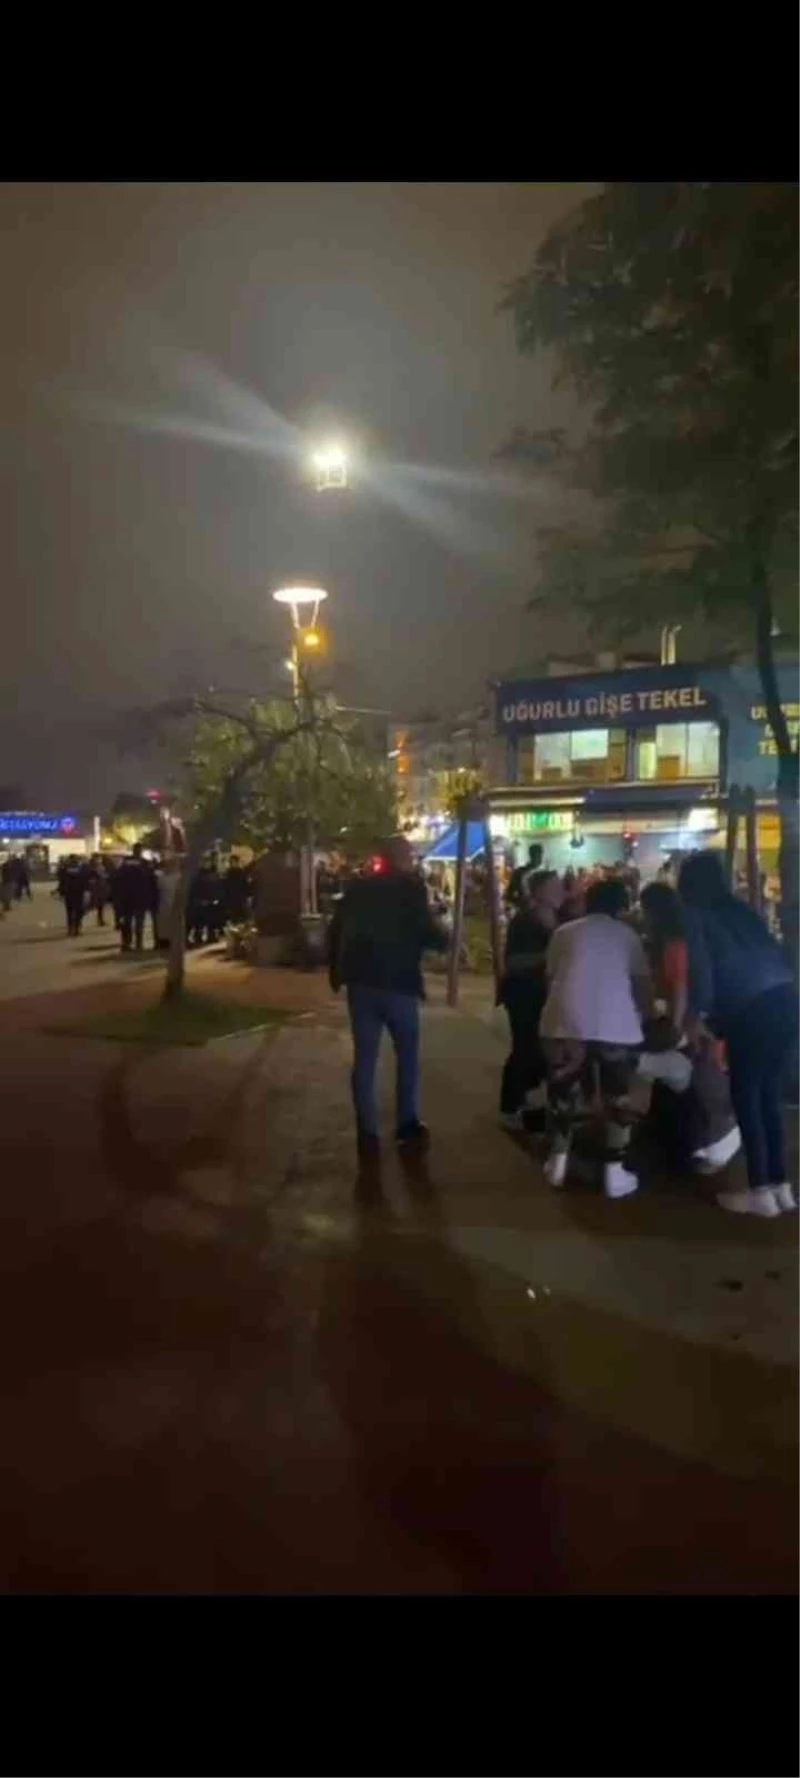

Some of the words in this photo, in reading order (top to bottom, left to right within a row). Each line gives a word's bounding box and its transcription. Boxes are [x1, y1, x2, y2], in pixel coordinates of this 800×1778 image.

[503, 699, 580, 722] UĞURLU
[585, 691, 633, 718] GİŞE
[635, 686, 707, 711] TEKEL
